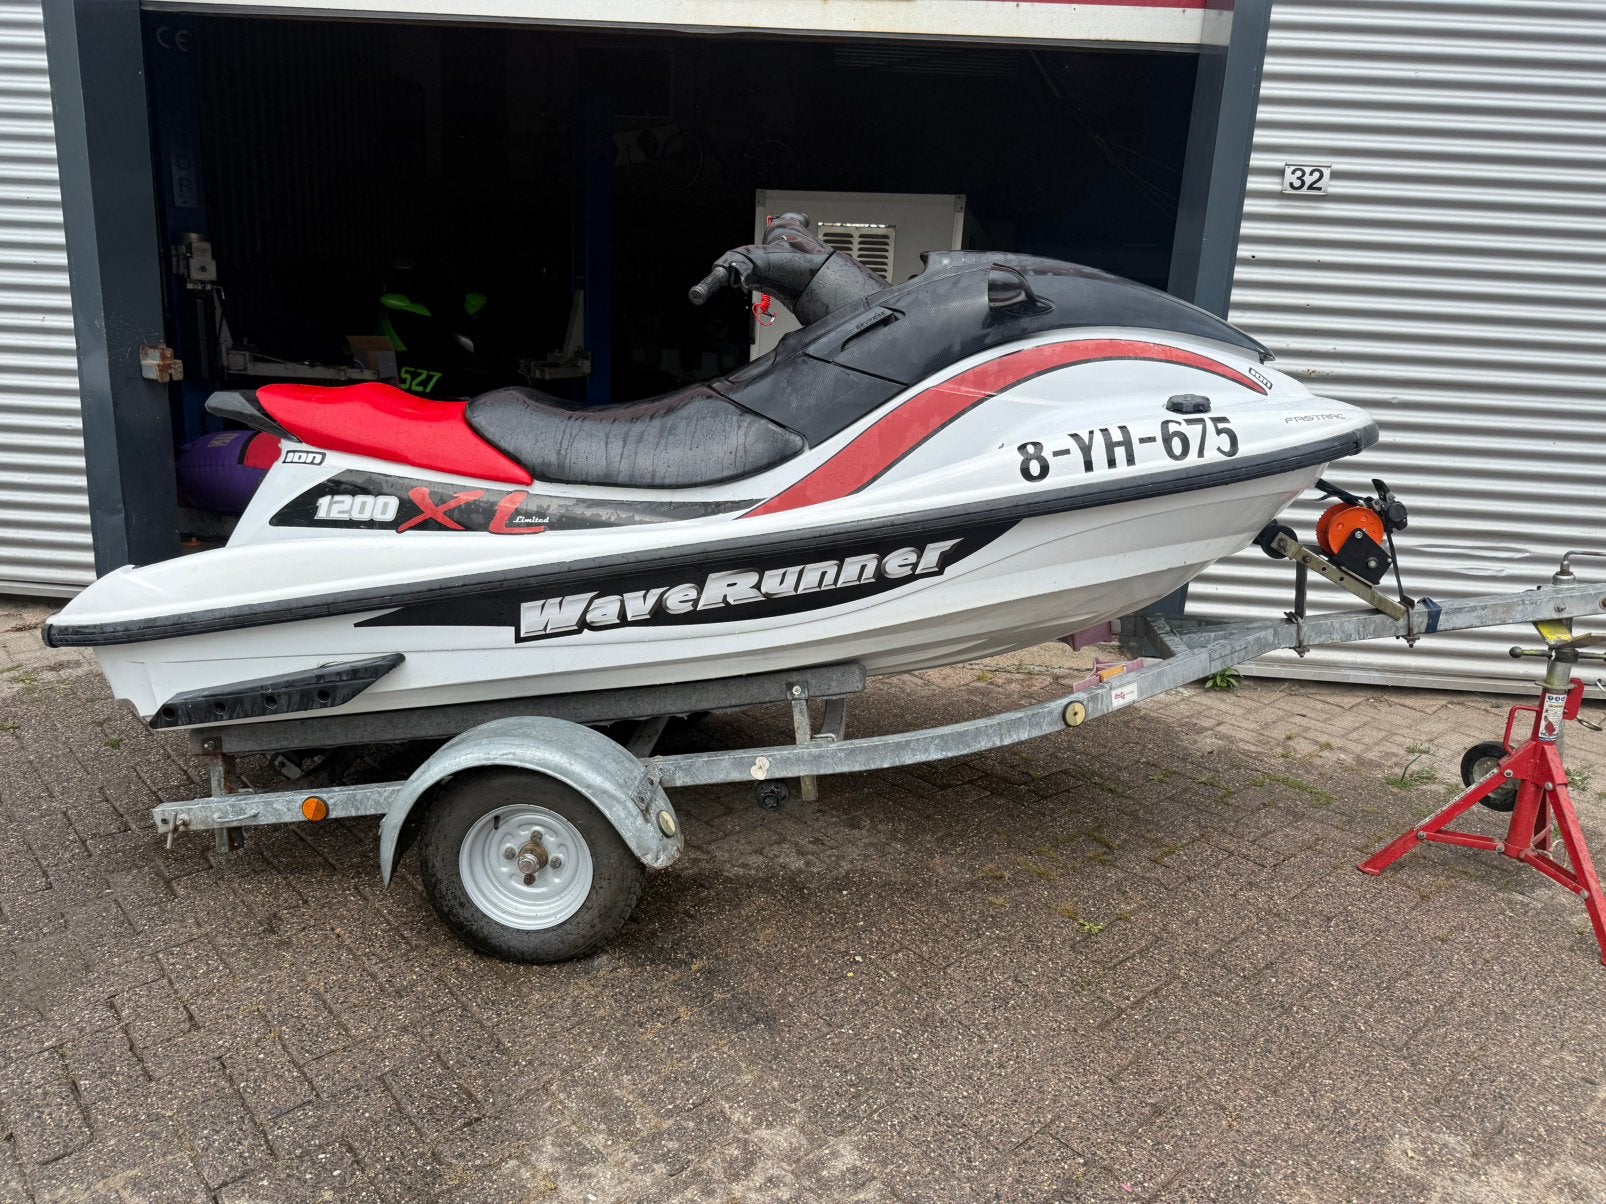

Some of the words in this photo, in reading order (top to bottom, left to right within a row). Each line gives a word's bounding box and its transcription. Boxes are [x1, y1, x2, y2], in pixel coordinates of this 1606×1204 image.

[1289, 167, 1324, 191] 32
[399, 366, 443, 393] 527
[1285, 413, 1346, 424] FASTRAC
[1017, 416, 1239, 482] 8-YH-675
[314, 494, 400, 522] 1200
[513, 515, 550, 523] Limited
[519, 537, 965, 637] WaveRunner
